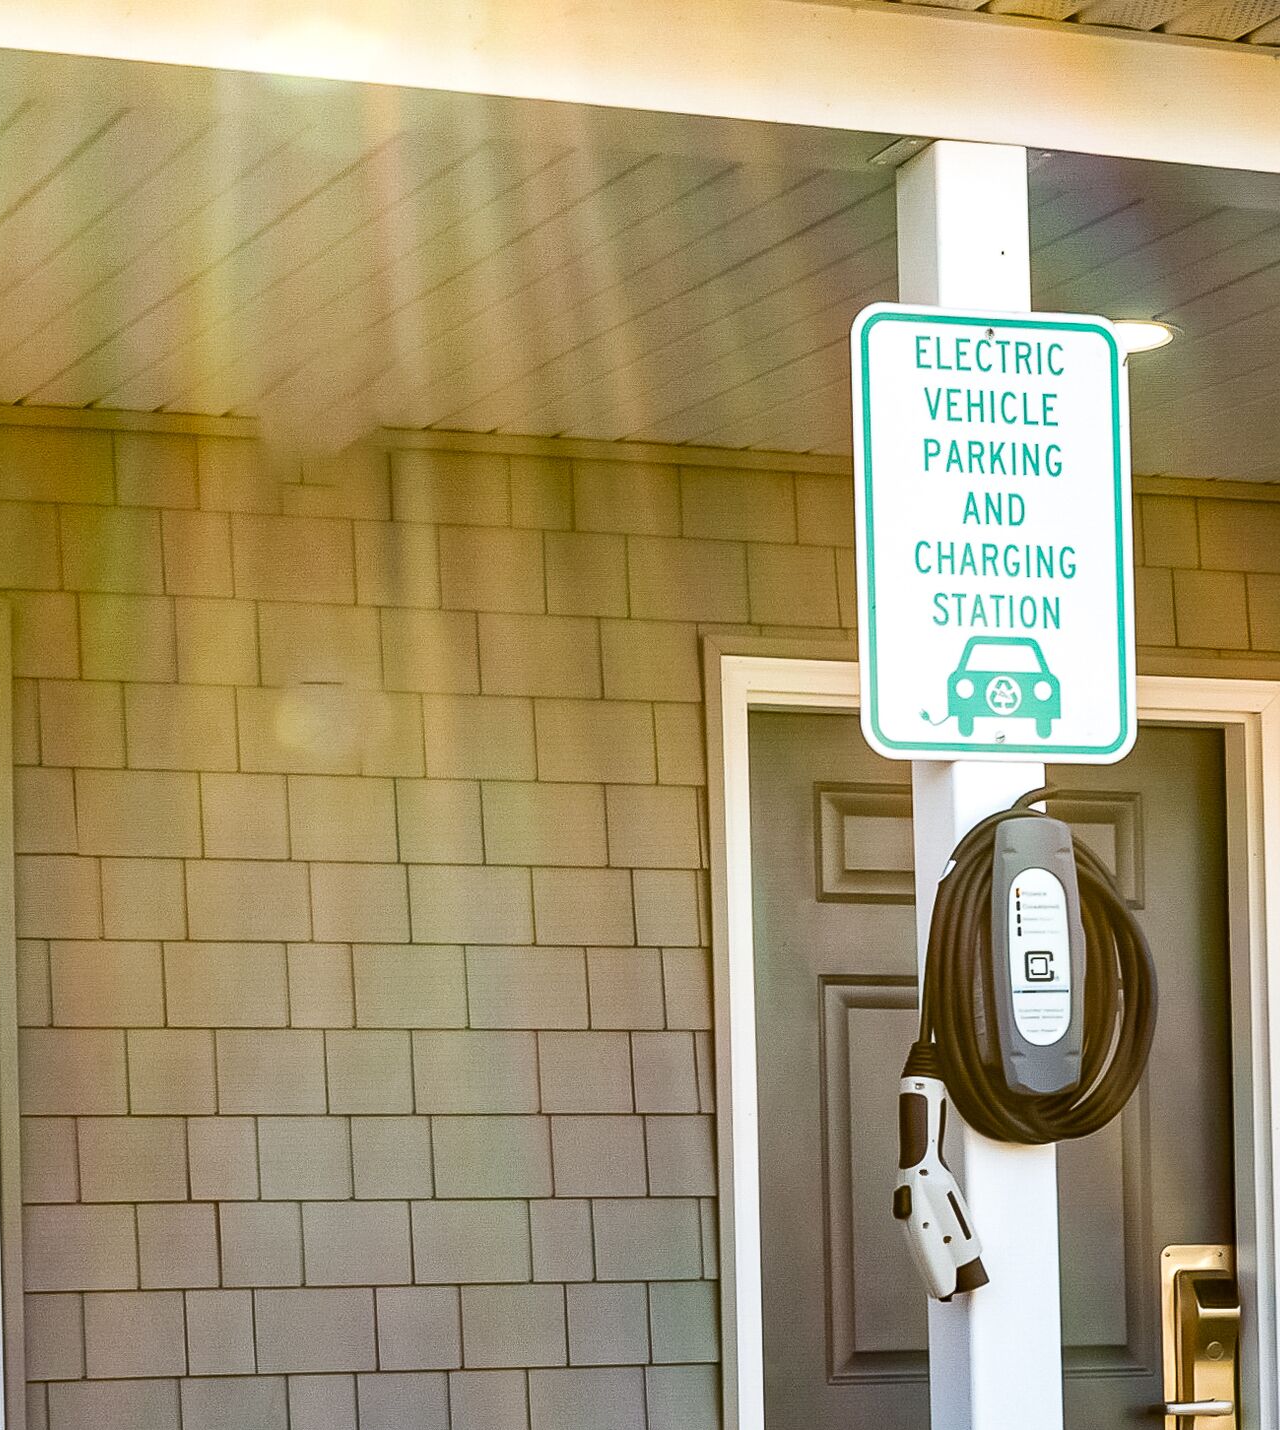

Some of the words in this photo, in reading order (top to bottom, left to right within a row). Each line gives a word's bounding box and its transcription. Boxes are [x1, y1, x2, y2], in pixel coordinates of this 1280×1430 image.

[915, 335, 1065, 377] ELECTRIC
[924, 387, 1058, 427] VEHICLE
[923, 437, 1063, 478] PARKING
[962, 491, 1026, 528] AND
[914, 540, 1077, 580] CHARGING
[932, 592, 1061, 631] STATION
